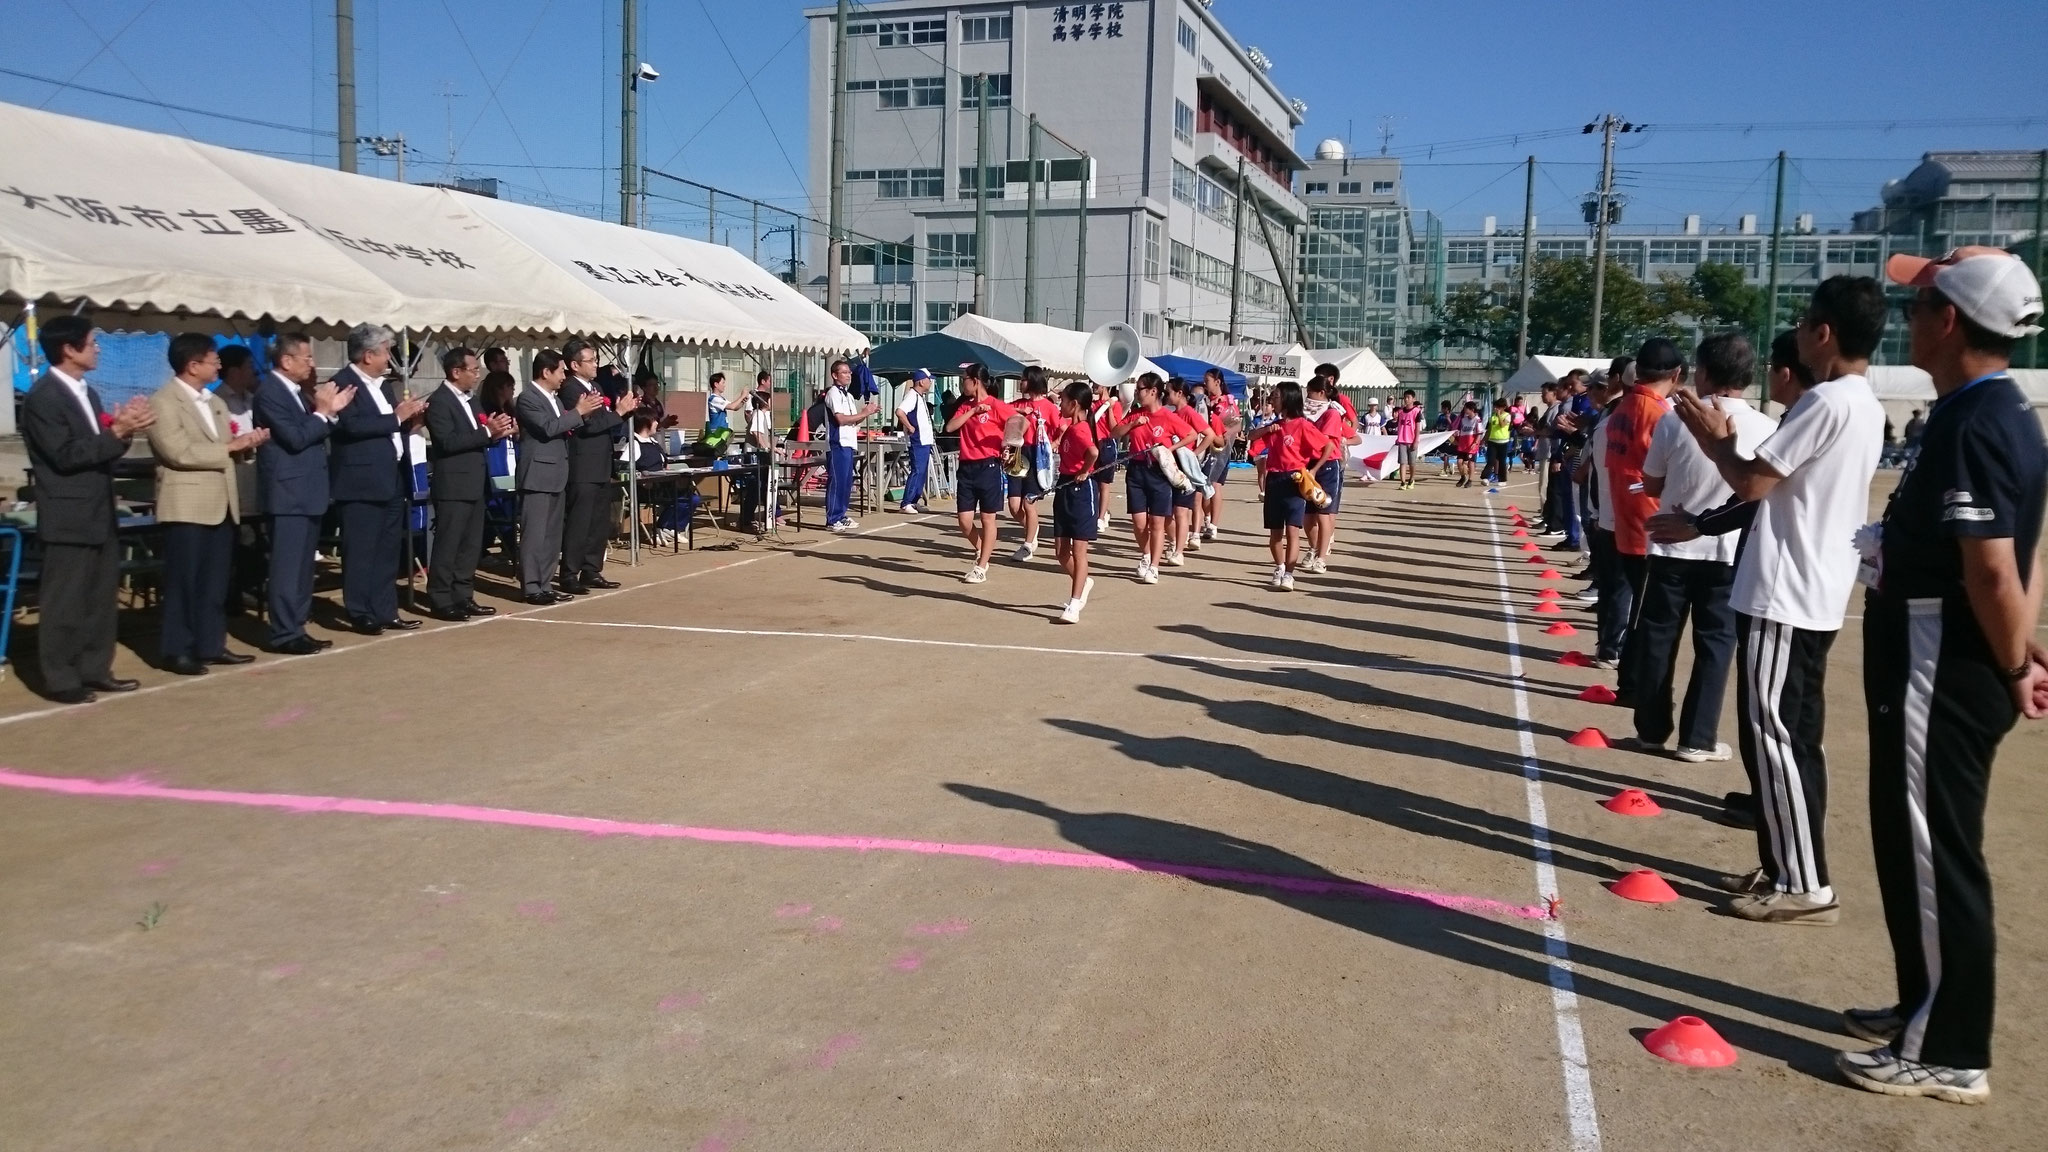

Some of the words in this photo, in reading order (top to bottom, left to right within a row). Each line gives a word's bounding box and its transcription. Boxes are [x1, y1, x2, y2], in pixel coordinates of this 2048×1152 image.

[1053, 2, 1124, 23] 清明学院
[1053, 21, 1123, 42] 高等学校
[1262, 355, 1272, 363] 57
